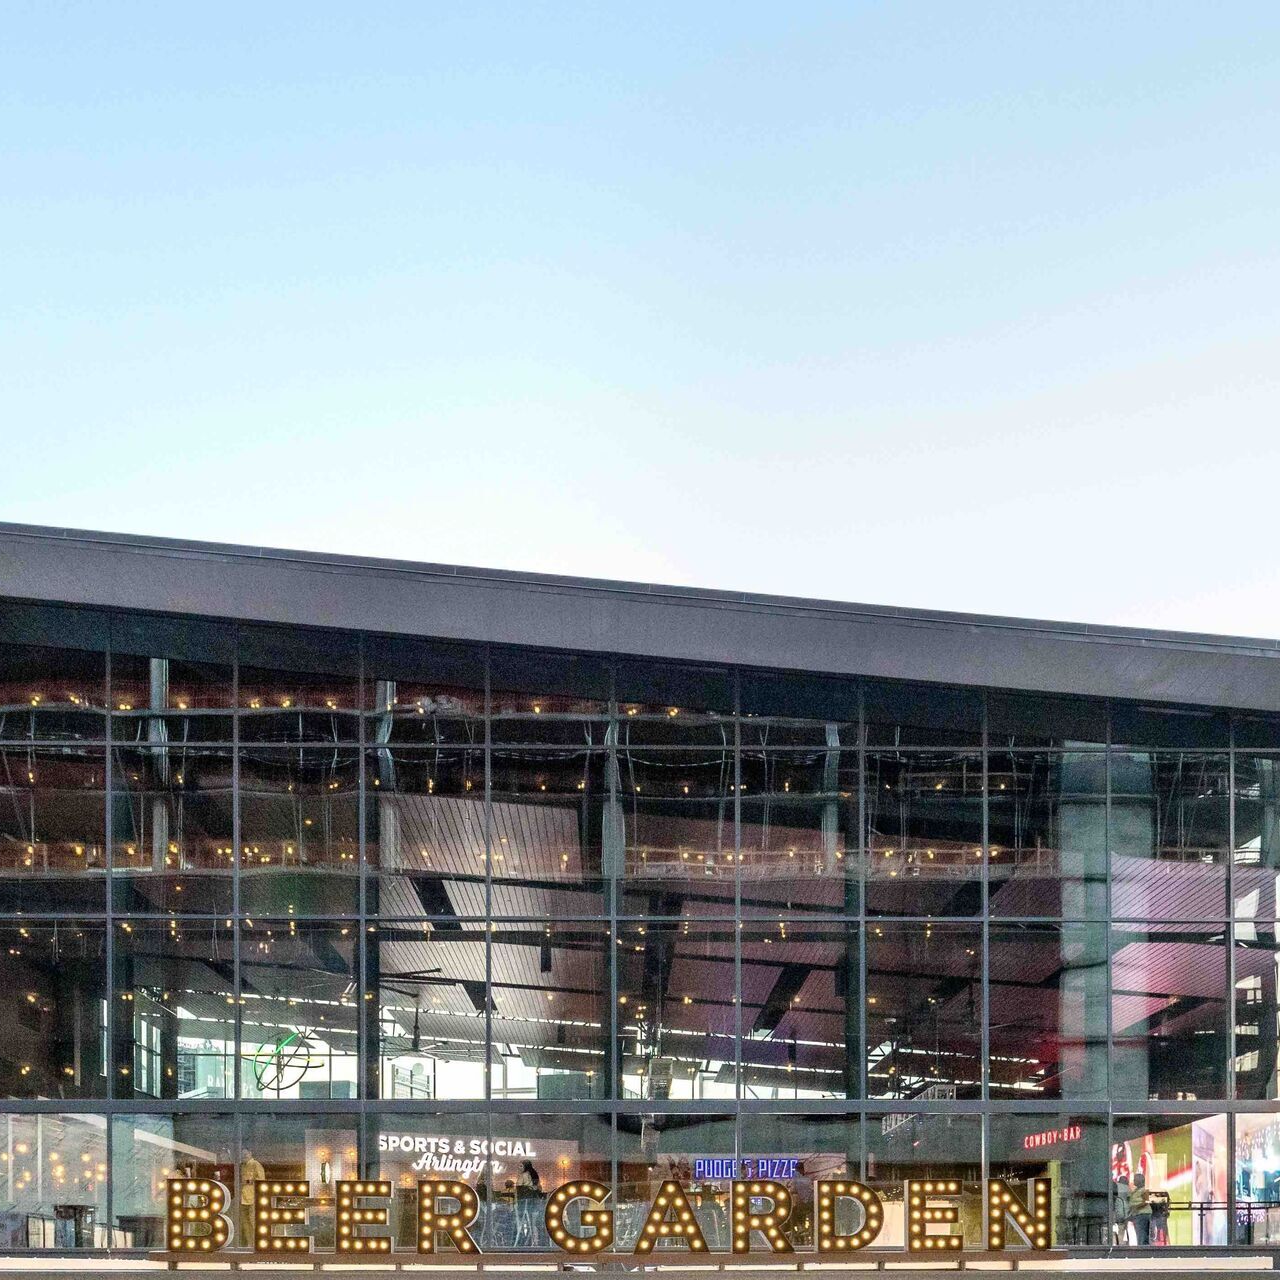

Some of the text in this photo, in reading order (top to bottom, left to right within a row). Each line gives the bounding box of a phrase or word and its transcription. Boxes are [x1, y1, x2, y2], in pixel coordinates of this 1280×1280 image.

[378, 1135, 451, 1153] SPORTS
[453, 1140, 466, 1155] &
[1024, 1126, 1081, 1149] COWBOY BAR
[167, 1178, 1053, 1254] BEER GARDEN
